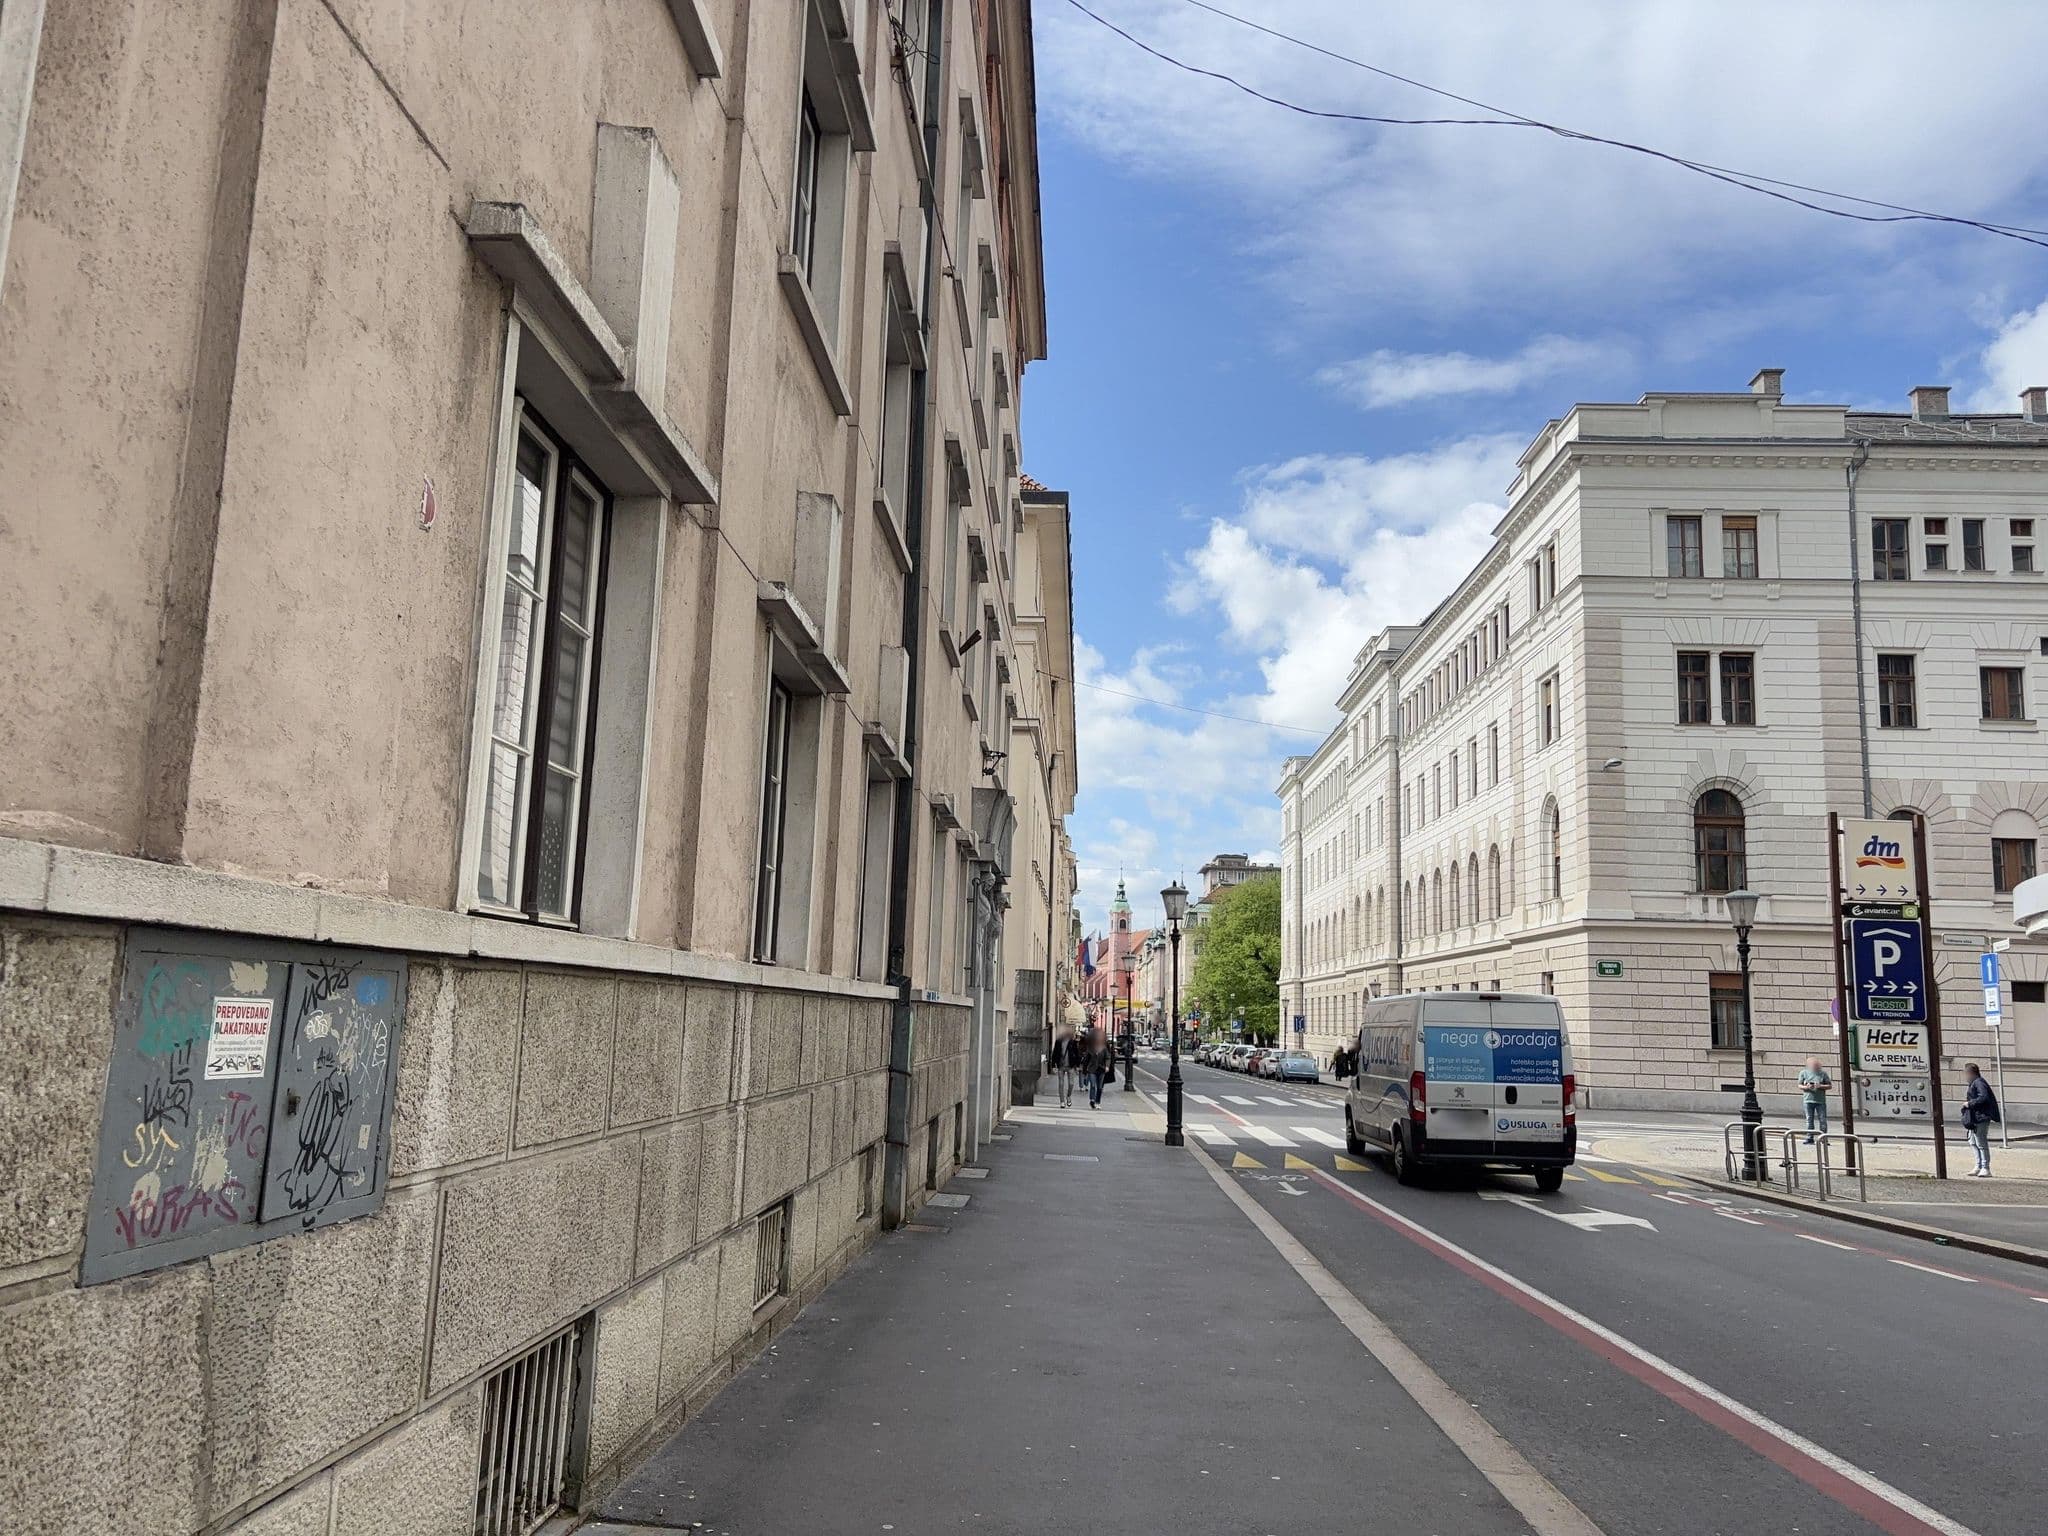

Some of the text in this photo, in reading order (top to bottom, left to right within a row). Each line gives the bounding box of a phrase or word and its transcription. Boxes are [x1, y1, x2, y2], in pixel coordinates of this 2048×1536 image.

[1863, 835, 1900, 857] dm
[1864, 906, 1900, 915] avantcar
[1873, 940, 1901, 977] P
[216, 1005, 269, 1020] PREPOVEDANO
[1871, 1001, 1906, 1010] PROSTO
[1440, 1032, 1478, 1047] nega
[1501, 1031, 1557, 1050] prodaja
[1867, 1029, 1919, 1045] Hertz
[1864, 1054, 1924, 1064] CAR RENTAL
[1510, 1120, 1547, 1129] USLUGA
